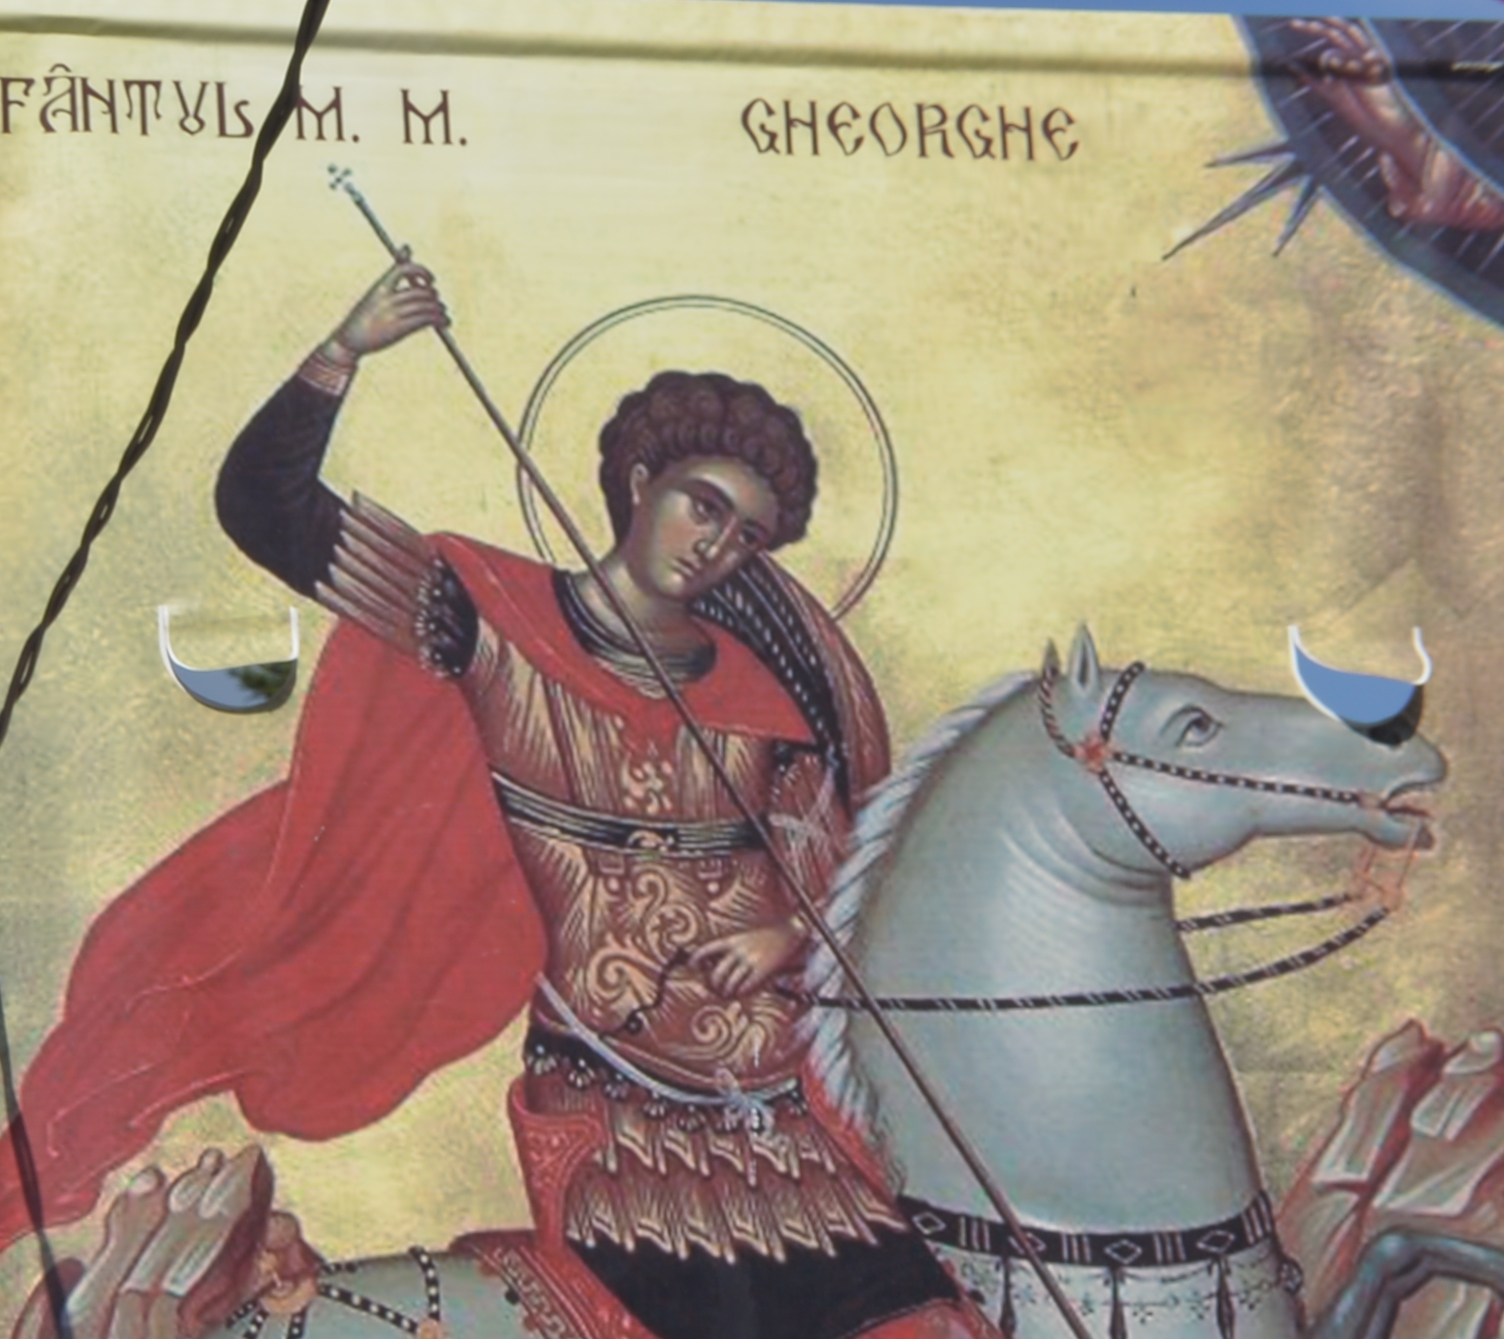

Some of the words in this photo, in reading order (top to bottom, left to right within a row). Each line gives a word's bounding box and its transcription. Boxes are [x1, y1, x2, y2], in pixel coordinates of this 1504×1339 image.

[294, 85, 360, 142] M.
[399, 88, 468, 146] M.
[740, 98, 1080, 161] GHEORGHE
